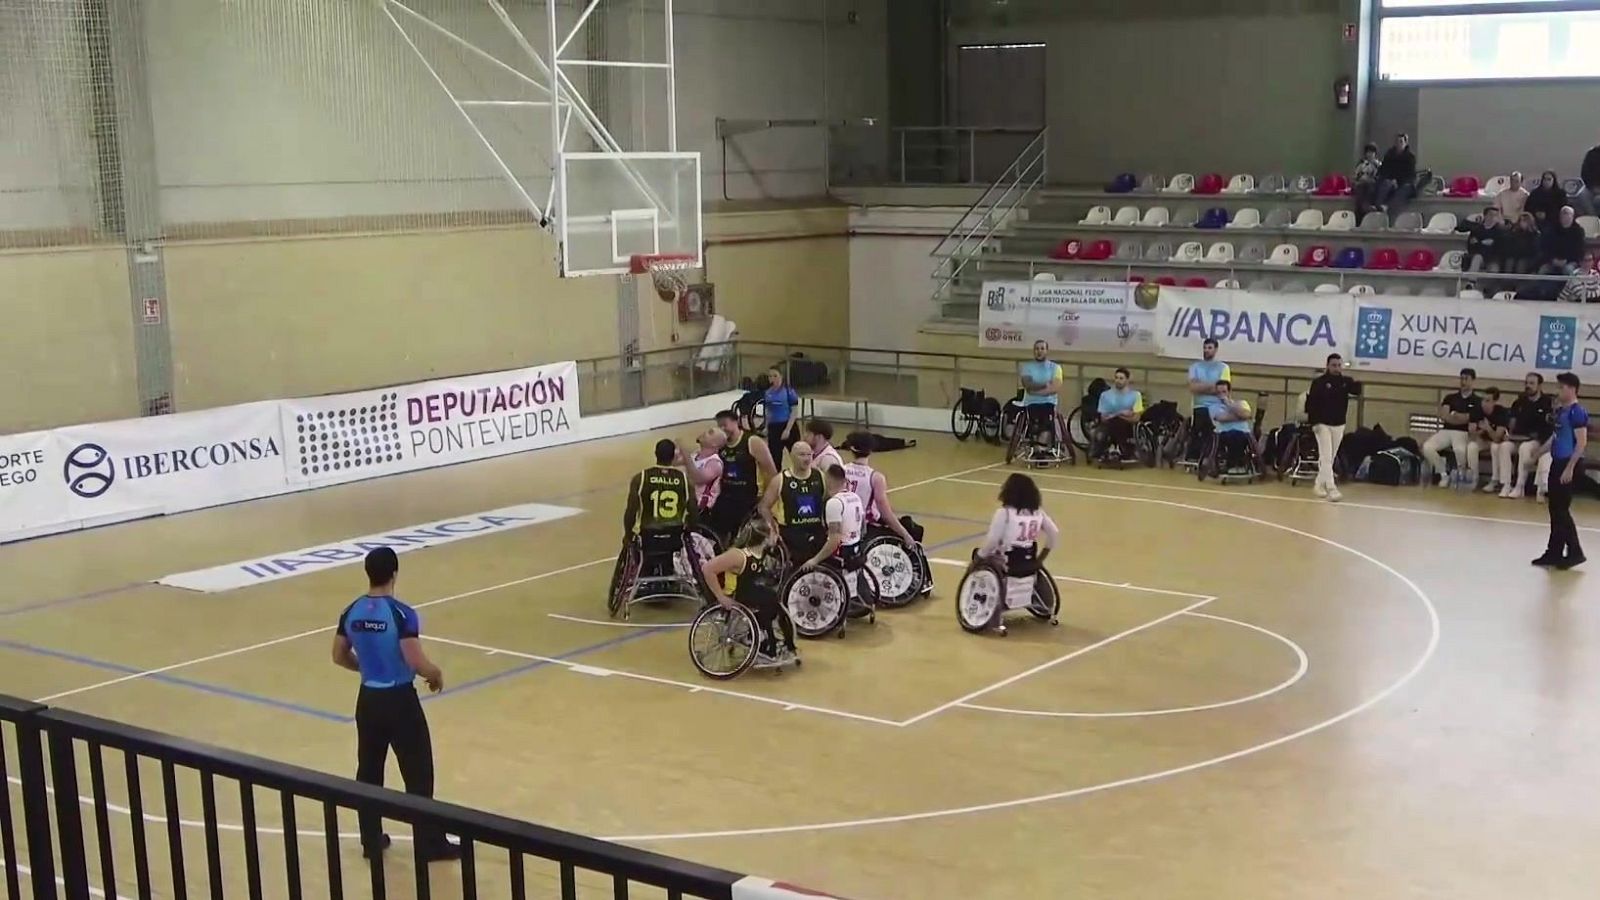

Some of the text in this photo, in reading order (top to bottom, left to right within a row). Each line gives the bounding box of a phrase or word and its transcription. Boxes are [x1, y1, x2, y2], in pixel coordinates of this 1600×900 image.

[1053, 288, 1083, 297] NACIONAL
[1400, 313, 1478, 335] XUNTA
[1396, 337, 1526, 363] DE GALICIA
[407, 371, 565, 426] DEPUTACIÓN
[410, 407, 570, 458] PONTEVEDRA
[123, 435, 280, 480] IBERCONSA
[650, 475, 680, 486] DIALLO
[650, 490, 679, 518] 13
